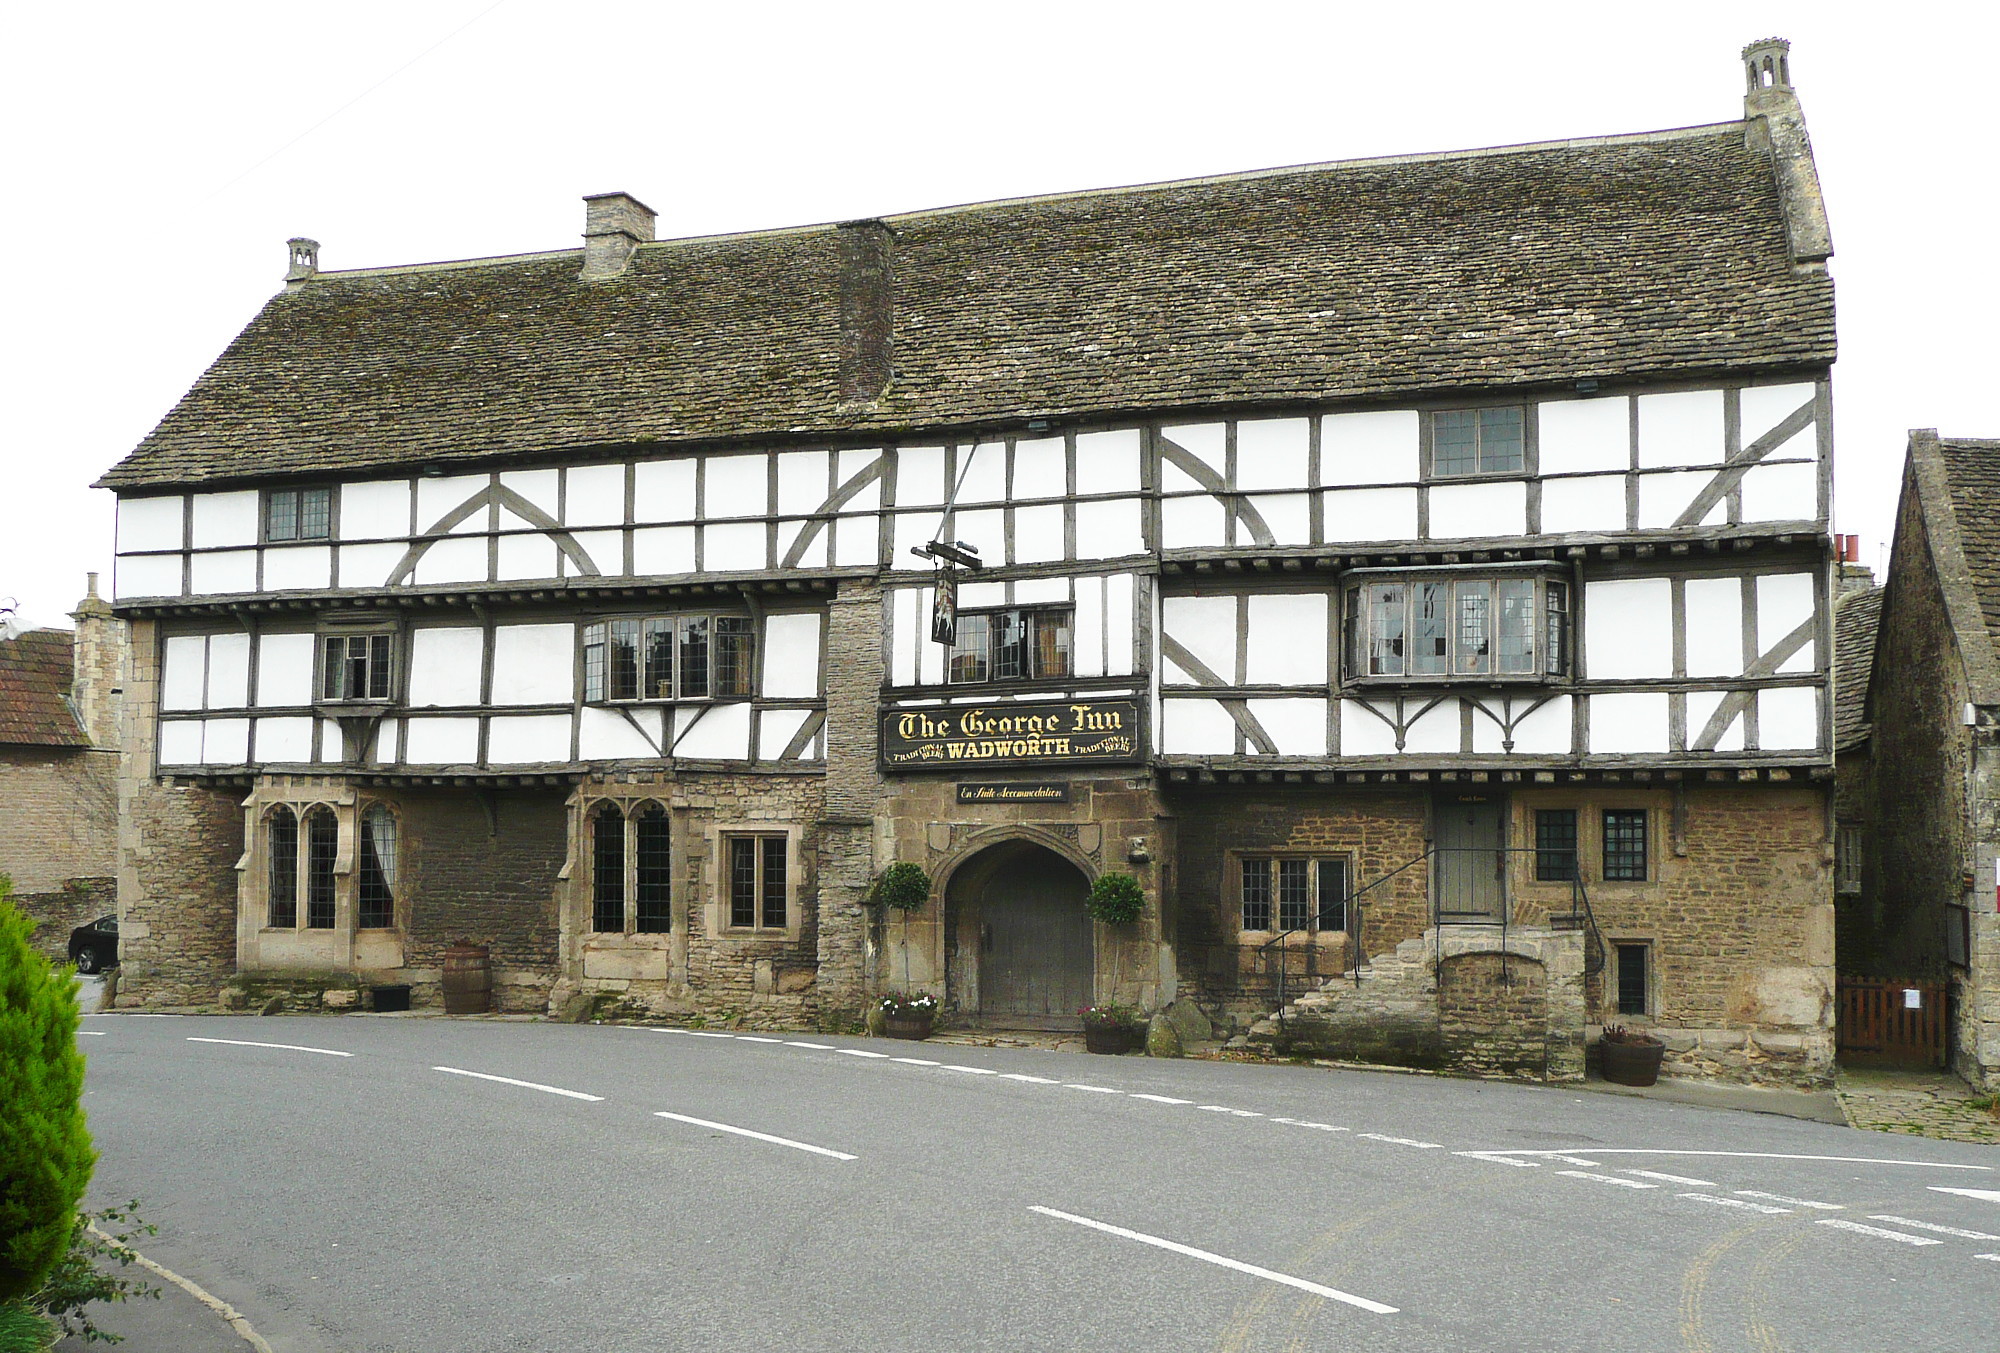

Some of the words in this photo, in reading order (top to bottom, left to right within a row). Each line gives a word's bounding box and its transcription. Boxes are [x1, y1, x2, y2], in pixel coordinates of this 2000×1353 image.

[899, 712, 951, 740] The
[961, 709, 1060, 739] George
[1070, 705, 1122, 731] Inn
[893, 744, 944, 761] TRADITIONAL
[946, 733, 1070, 759] WADWORTH
[1074, 736, 1131, 754] TRADITIONAL
[960, 786, 972, 799] En
[997, 785, 1062, 798] Accommodation
